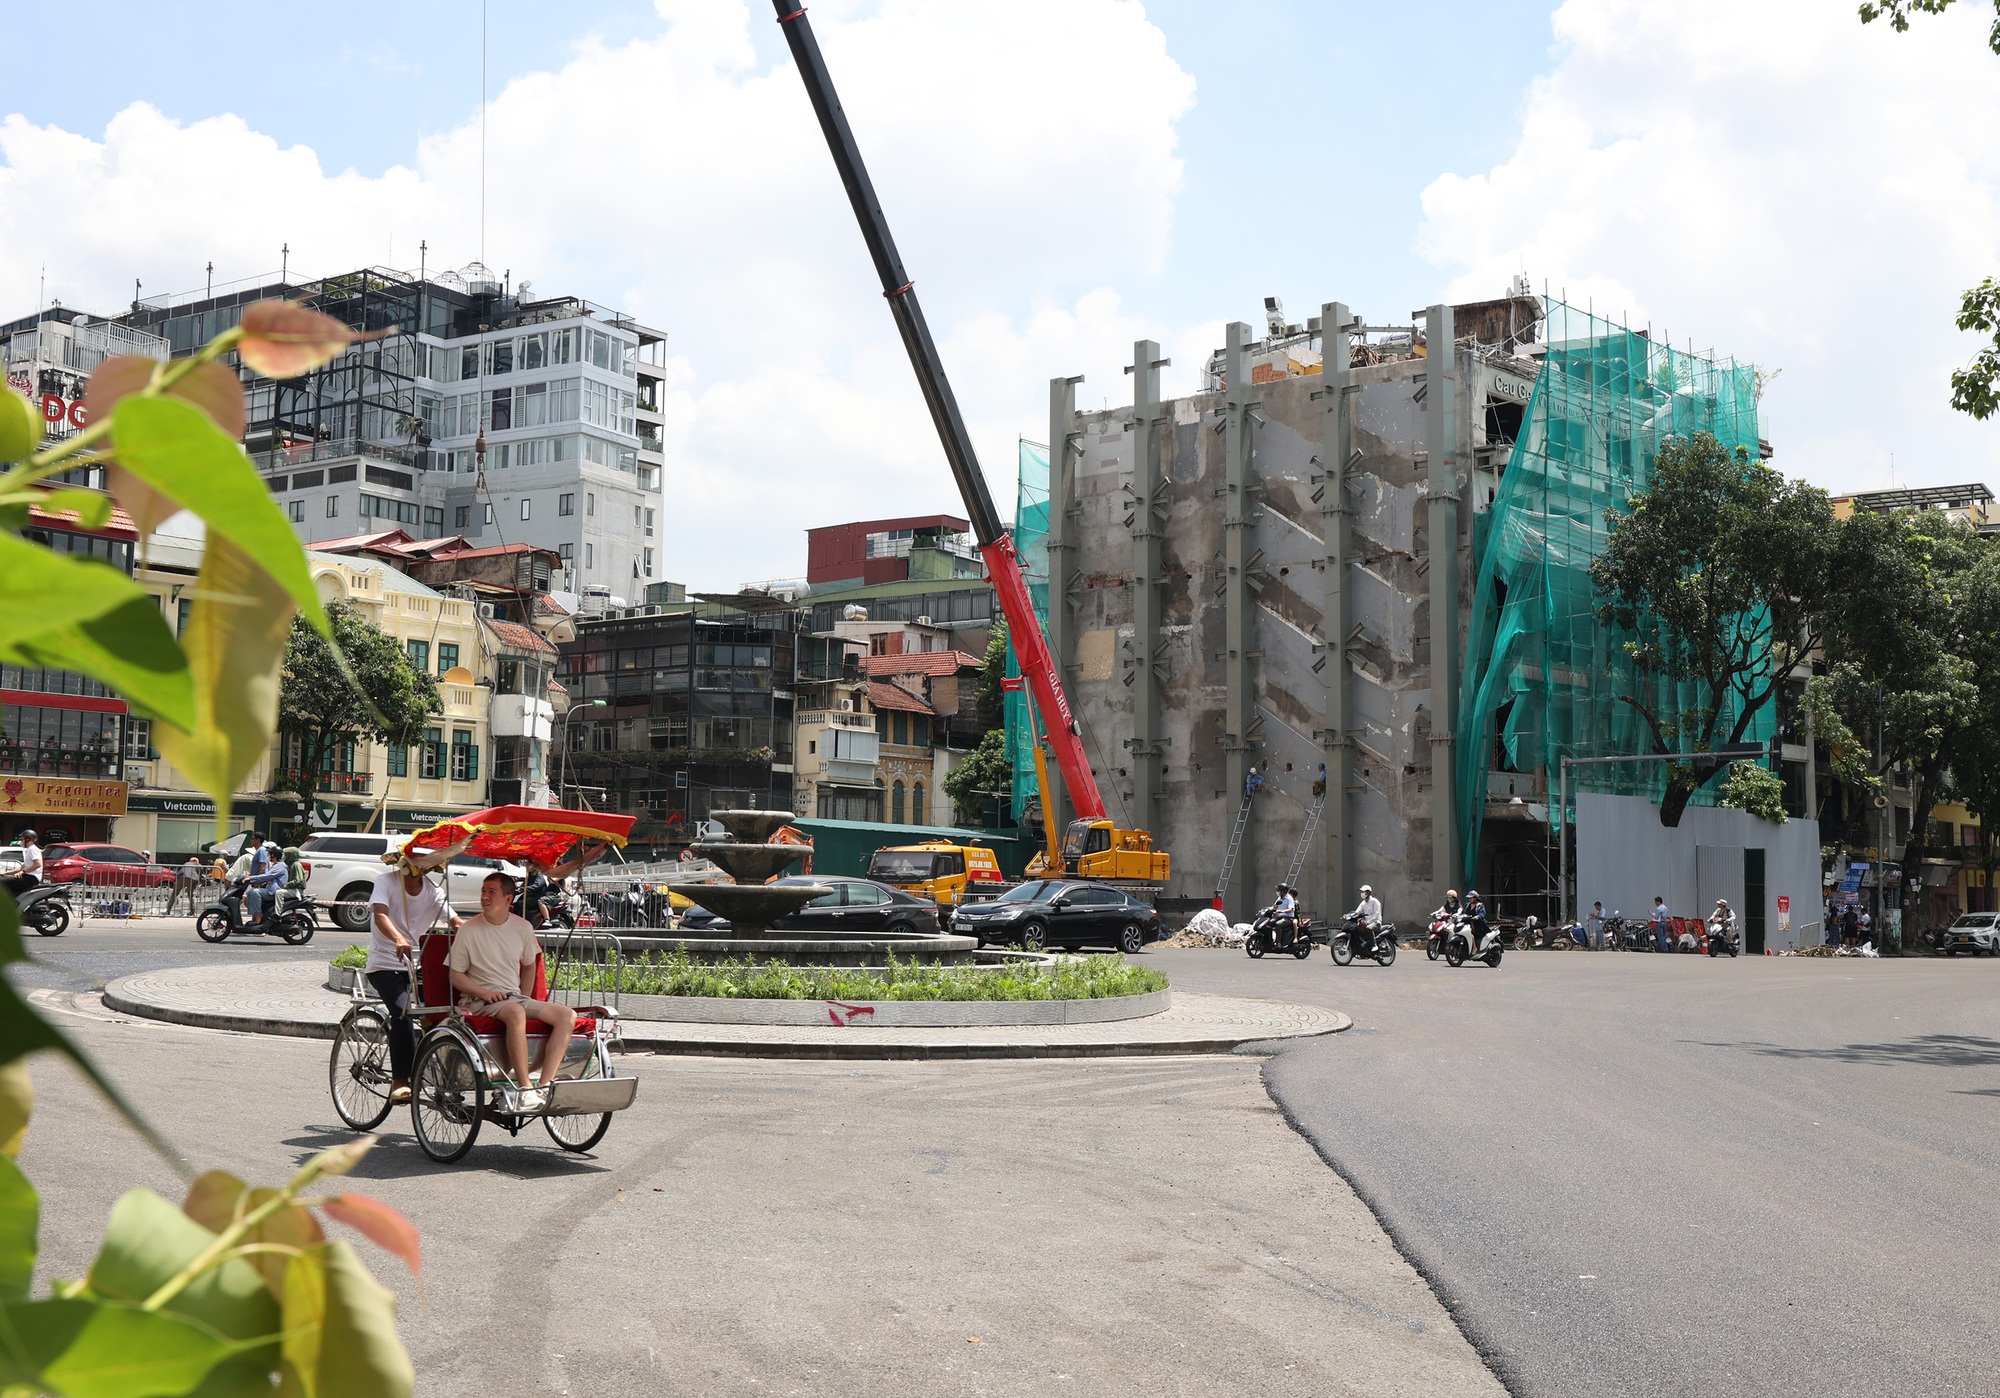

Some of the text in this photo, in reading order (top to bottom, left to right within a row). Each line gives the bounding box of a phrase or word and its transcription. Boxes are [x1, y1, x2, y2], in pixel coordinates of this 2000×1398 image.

[1495, 375, 1515, 396] Cau
[1049, 672, 1070, 719] GIA HUY
[36, 782, 121, 797] Dragon Tea
[163, 801, 218, 812] Vietcomban
